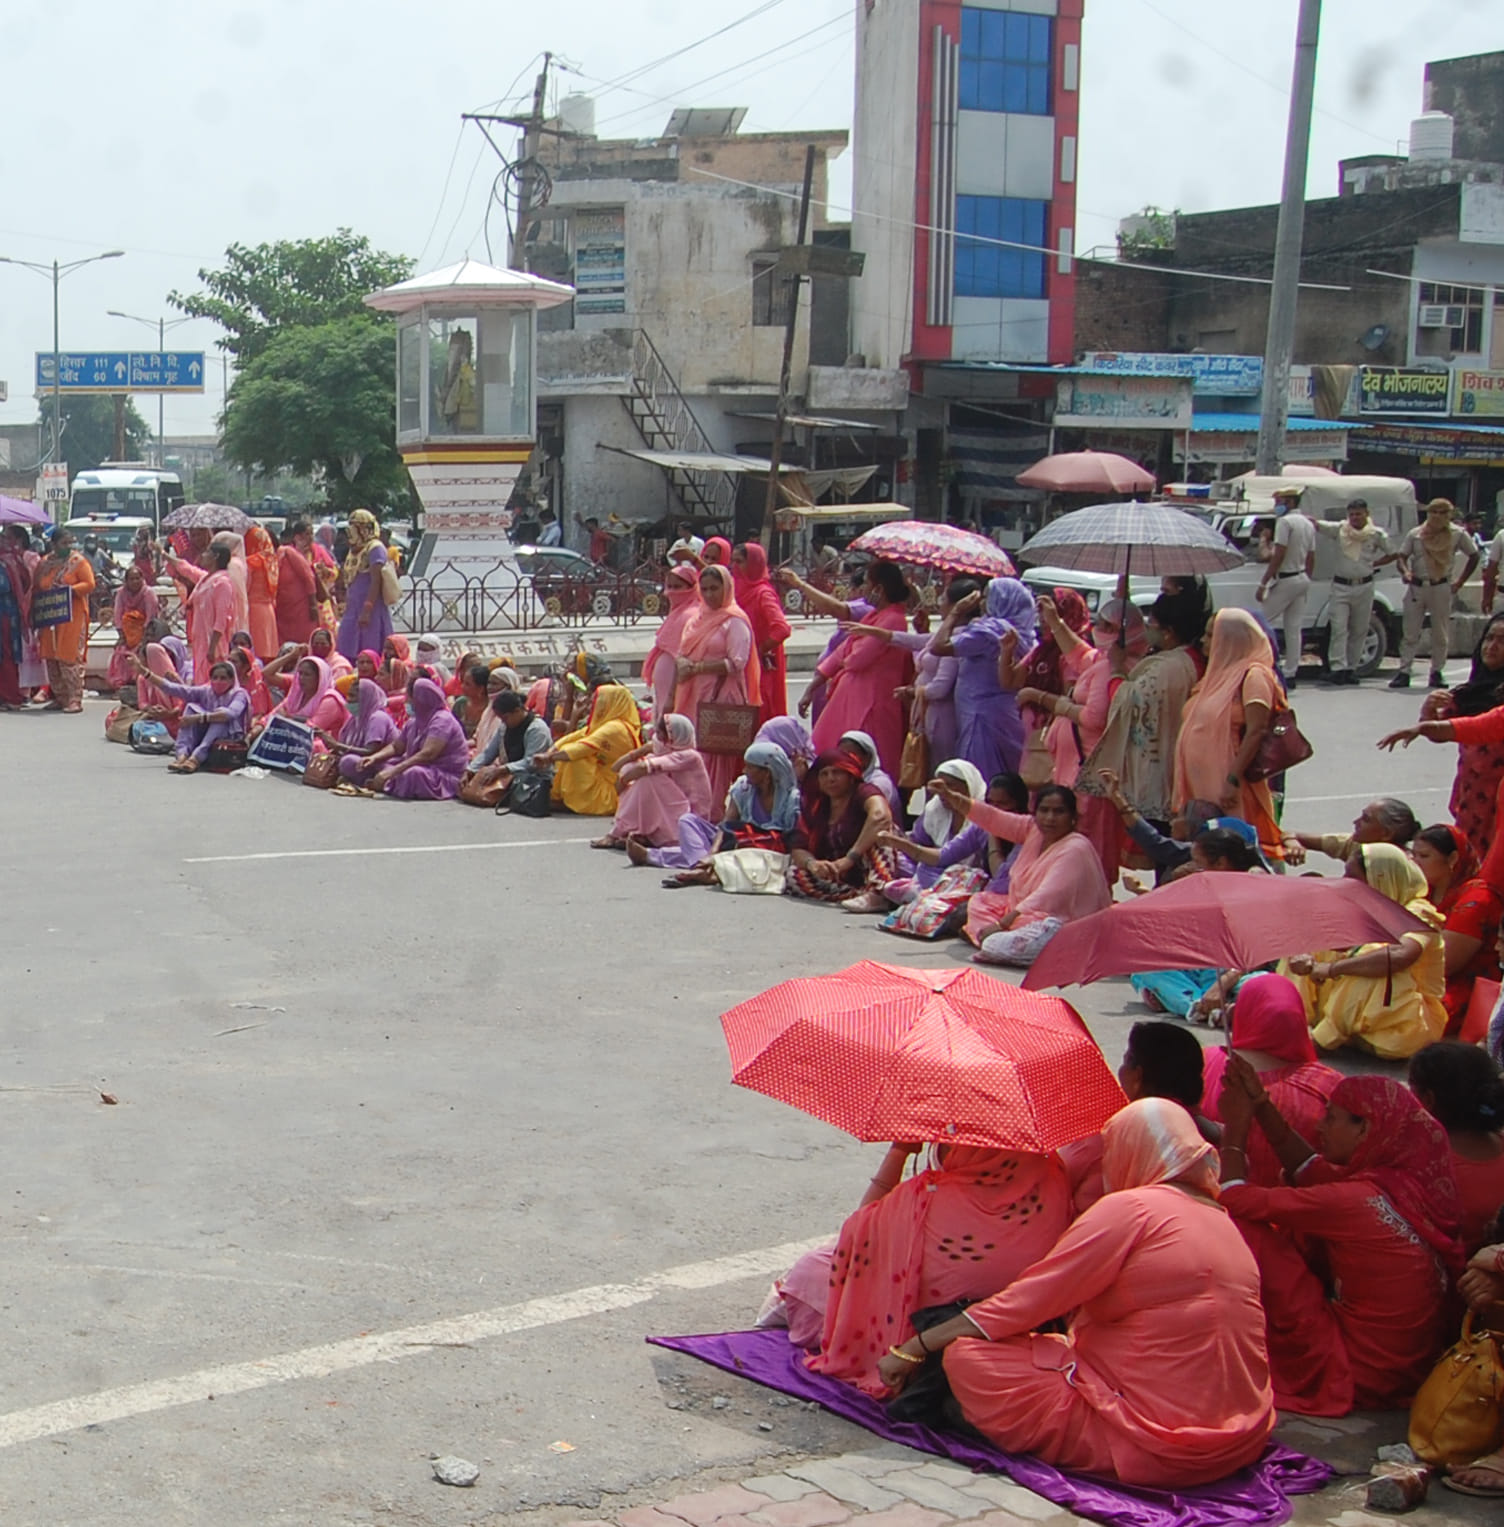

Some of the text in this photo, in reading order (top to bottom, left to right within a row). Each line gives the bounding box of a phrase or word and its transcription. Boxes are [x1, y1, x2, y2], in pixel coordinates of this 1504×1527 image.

[59, 354, 109, 369] हिसार 111
[1362, 368, 1448, 394] देव भोजनालय
[46, 487, 66, 498] 1075
